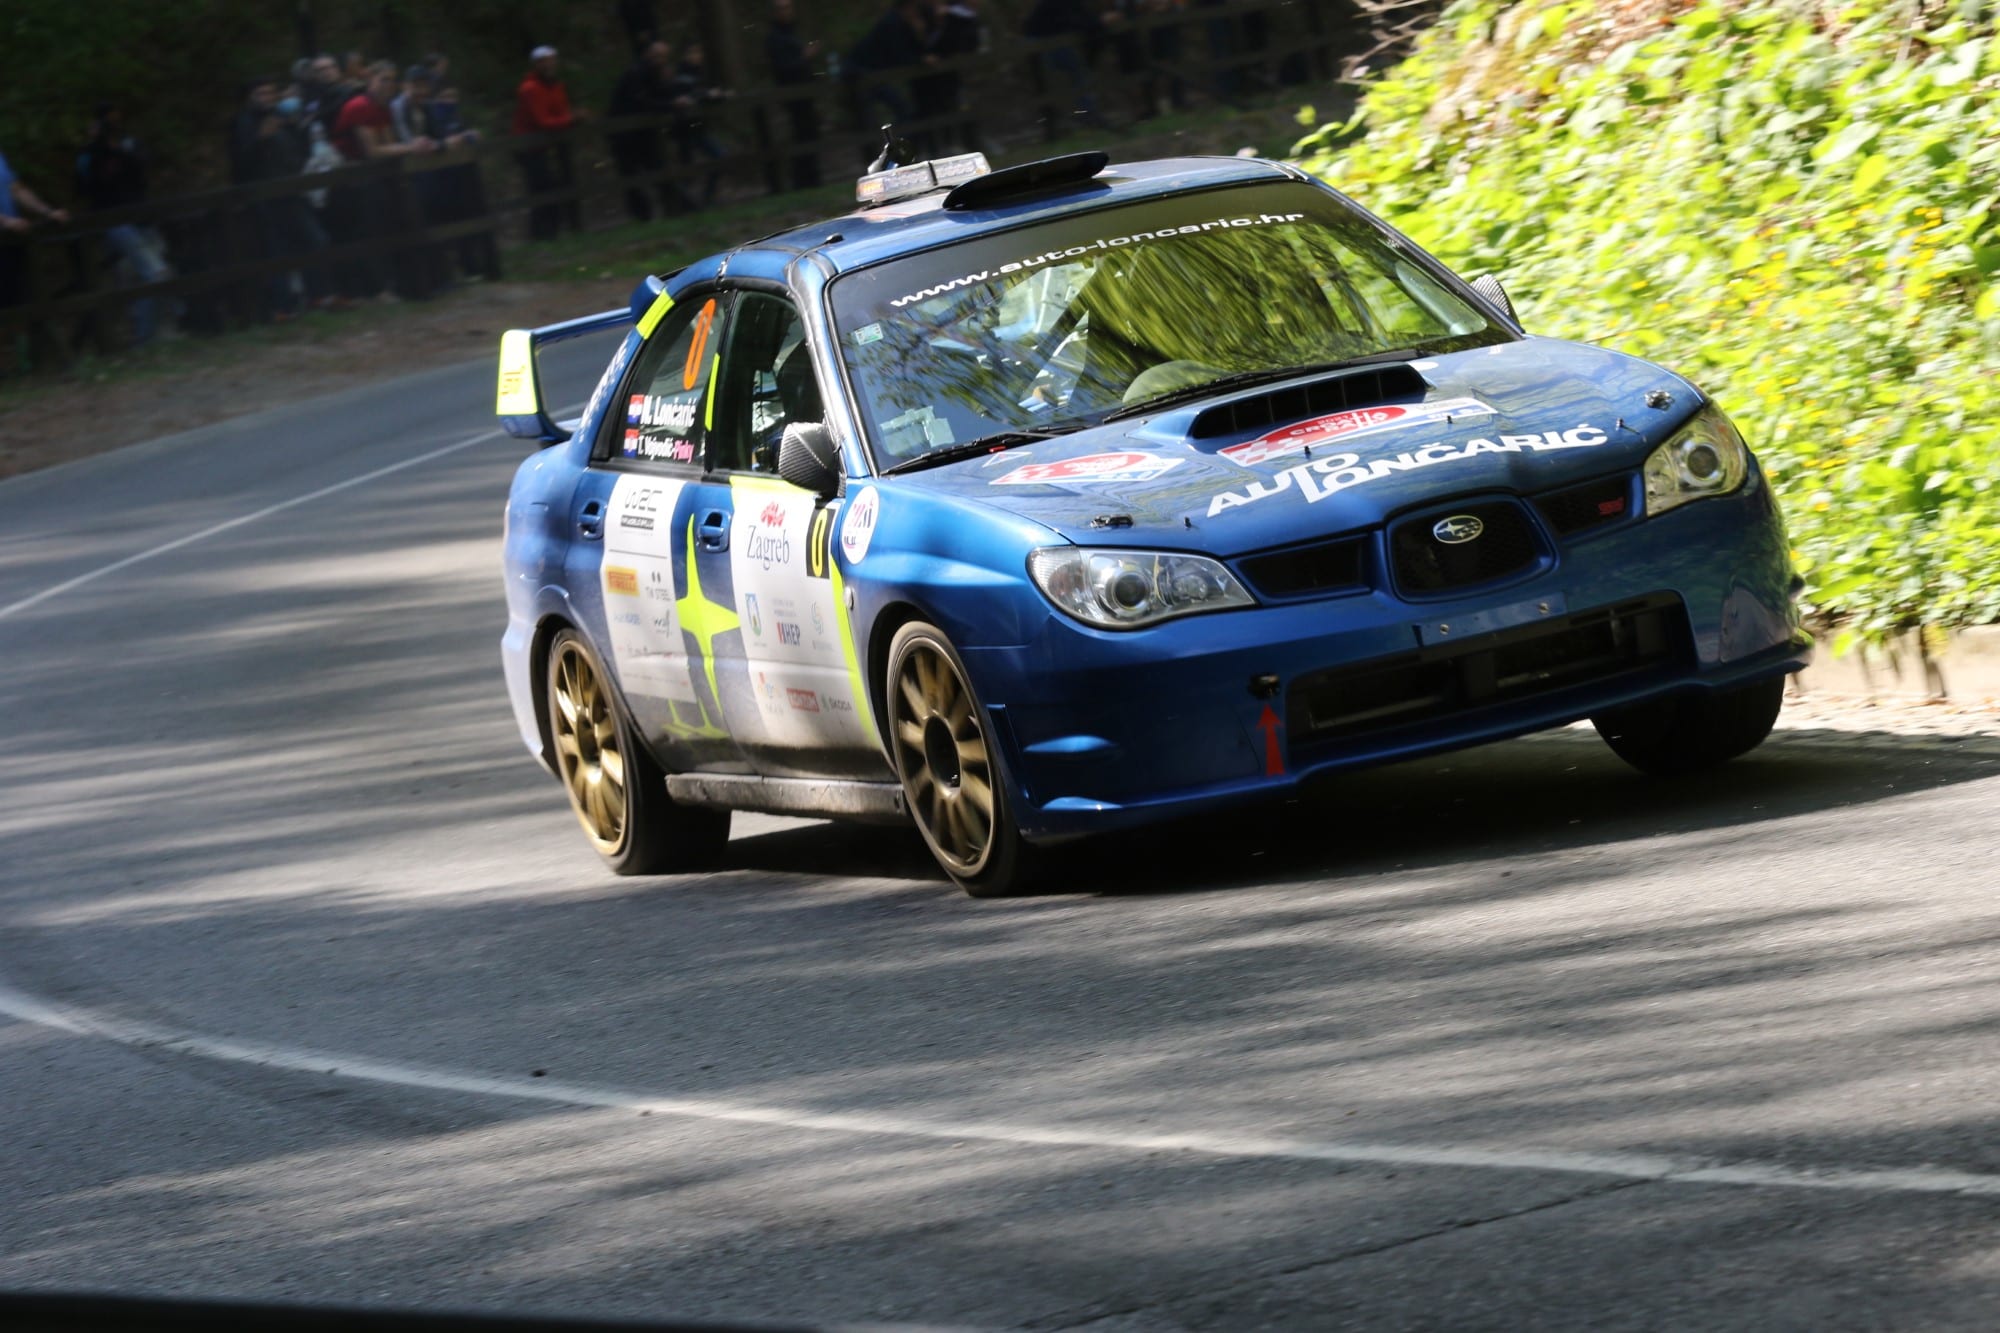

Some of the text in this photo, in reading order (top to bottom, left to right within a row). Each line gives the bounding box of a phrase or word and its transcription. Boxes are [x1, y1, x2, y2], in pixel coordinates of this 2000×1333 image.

[890, 213, 1304, 308] www.auto-loncaric.hr
[683, 298, 716, 390] 0
[1206, 453, 1359, 517] AUTO
[746, 525, 790, 571] Zagreb
[811, 508, 828, 578] 0
